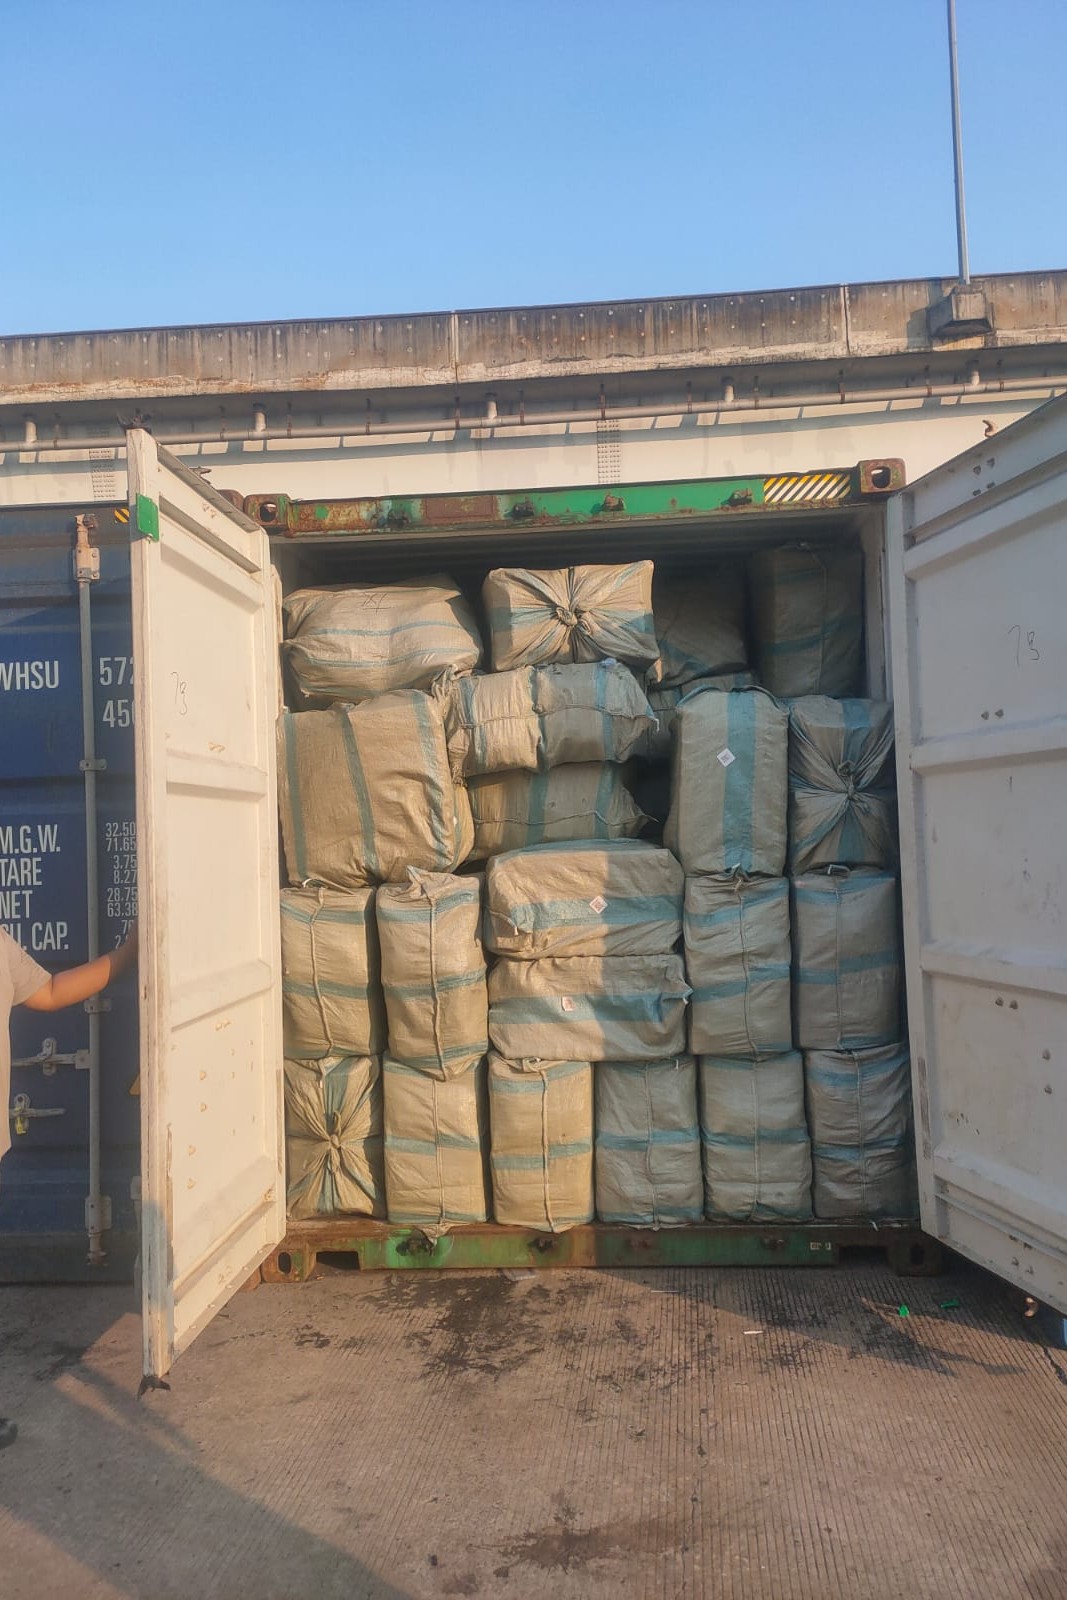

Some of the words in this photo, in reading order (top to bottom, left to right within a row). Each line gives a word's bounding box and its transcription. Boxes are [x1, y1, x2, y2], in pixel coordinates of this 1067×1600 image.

[102, 699, 136, 728] 45
[0, 857, 43, 887] TARE
[0, 890, 33, 919] NET
[31, 920, 69, 951] CAP.
